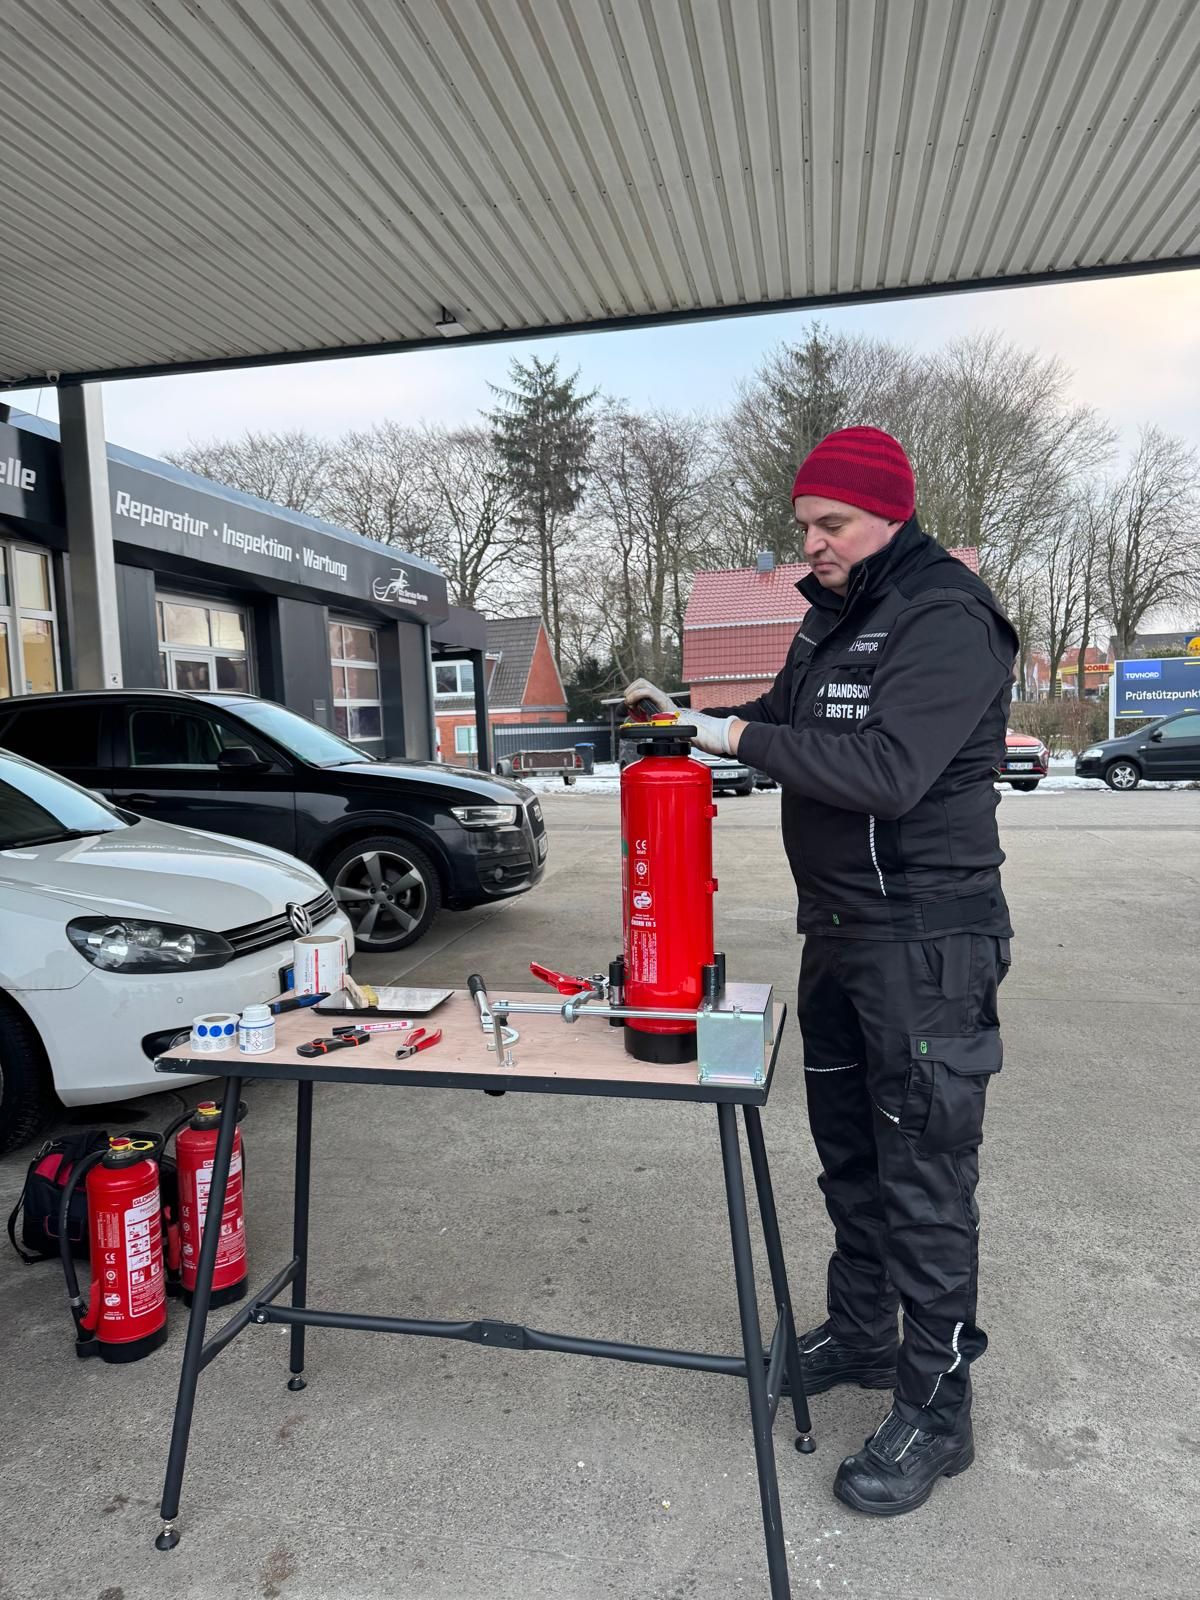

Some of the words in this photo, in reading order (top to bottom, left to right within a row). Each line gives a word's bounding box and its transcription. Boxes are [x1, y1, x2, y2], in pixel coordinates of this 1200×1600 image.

[115, 490, 209, 538] Reparatur
[222, 523, 293, 562] Inspektion
[303, 547, 348, 581] Wartung
[827, 683, 872, 699] BRANDSCH
[826, 703, 854, 719] ERSTE
